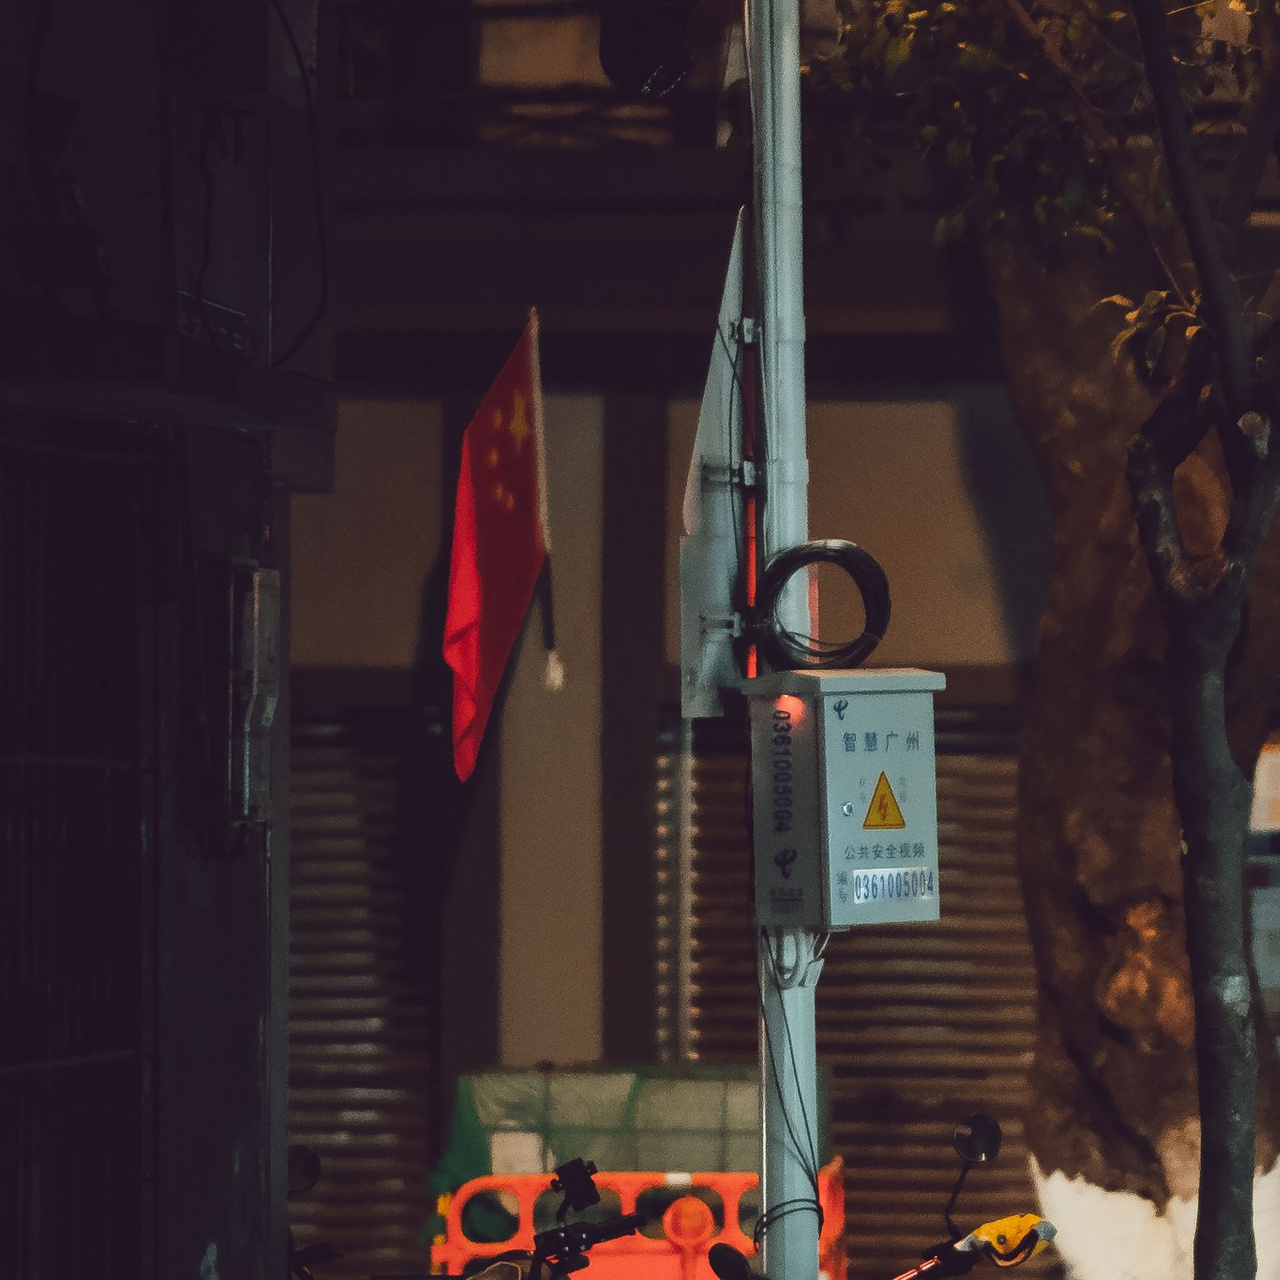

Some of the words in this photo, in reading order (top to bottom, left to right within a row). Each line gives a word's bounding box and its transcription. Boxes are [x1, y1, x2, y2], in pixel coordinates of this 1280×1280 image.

[843, 730, 921, 753] 智慧广州
[772, 709, 793, 833] 0361005004
[844, 842, 926, 861] 公共安全视频
[855, 870, 934, 900] 0361005004
